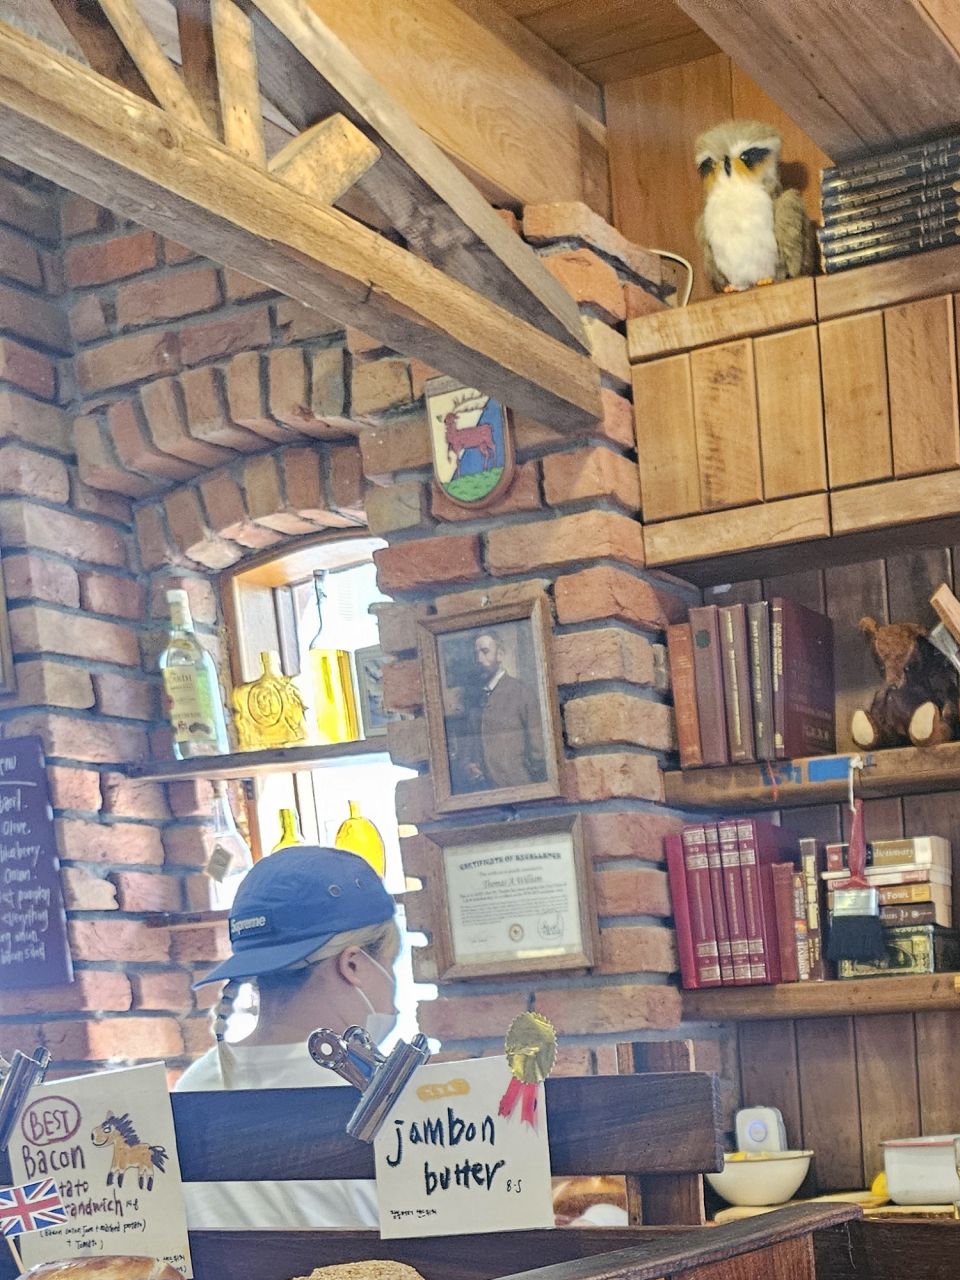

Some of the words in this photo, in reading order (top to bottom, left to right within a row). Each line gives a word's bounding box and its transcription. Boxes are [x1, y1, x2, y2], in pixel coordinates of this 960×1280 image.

[29, 1109, 70, 1141] BEST
[386, 1107, 495, 1167] jambon
[22, 1145, 86, 1180] Bacon
[425, 1159, 506, 1195] butter
[58, 1180, 90, 1198] tato
